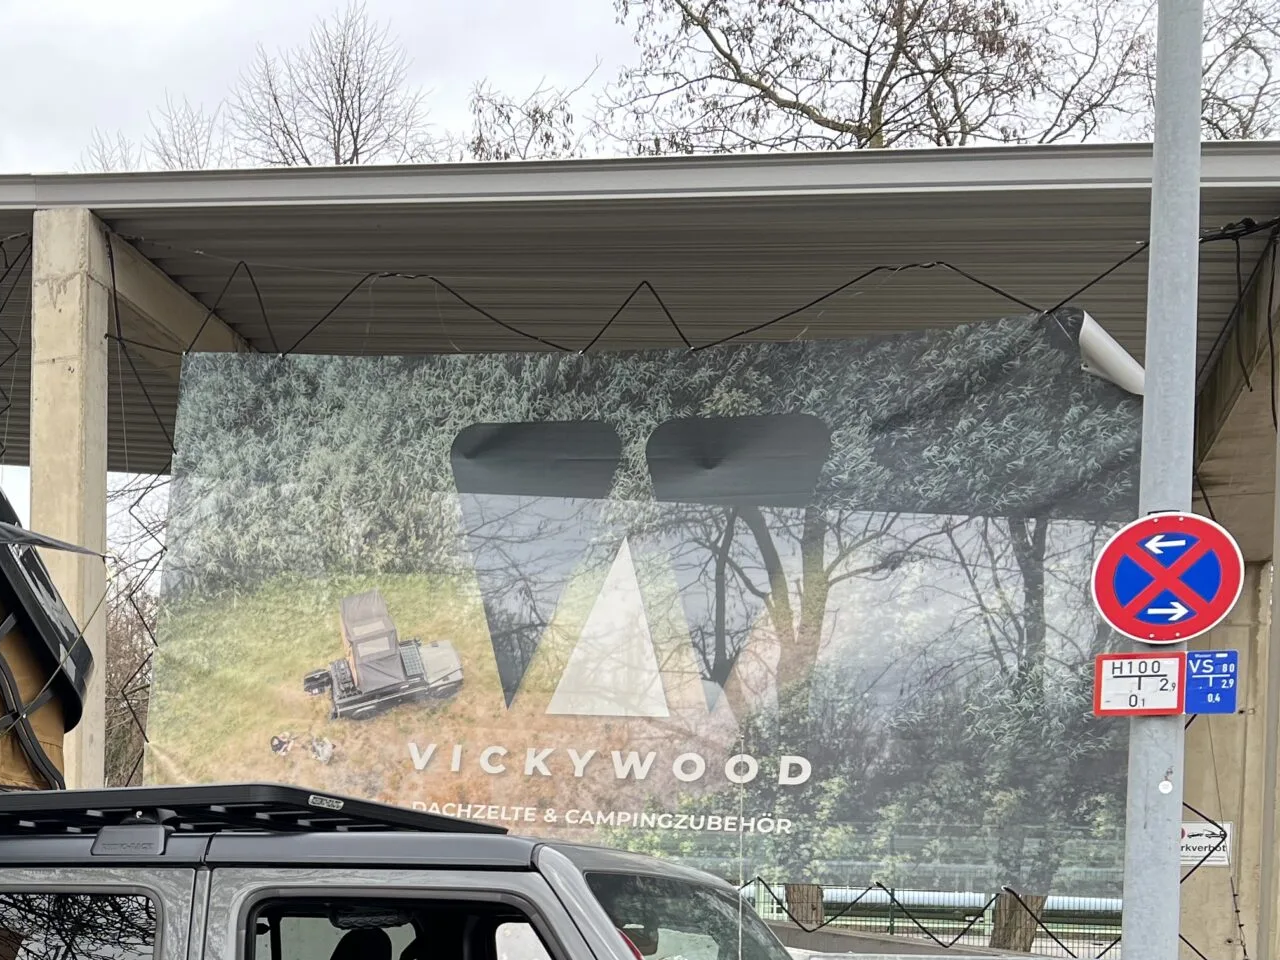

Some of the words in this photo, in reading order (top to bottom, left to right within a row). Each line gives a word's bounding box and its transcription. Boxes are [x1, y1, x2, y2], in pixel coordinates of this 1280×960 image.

[1111, 660, 1161, 675] H100
[1189, 659, 1214, 673] VS
[407, 742, 813, 787] VICKYWOOD
[543, 808, 558, 823] &
[565, 808, 793, 835] CAMPINGZUBEHÖR
[1180, 843, 1226, 852] rkverbot
